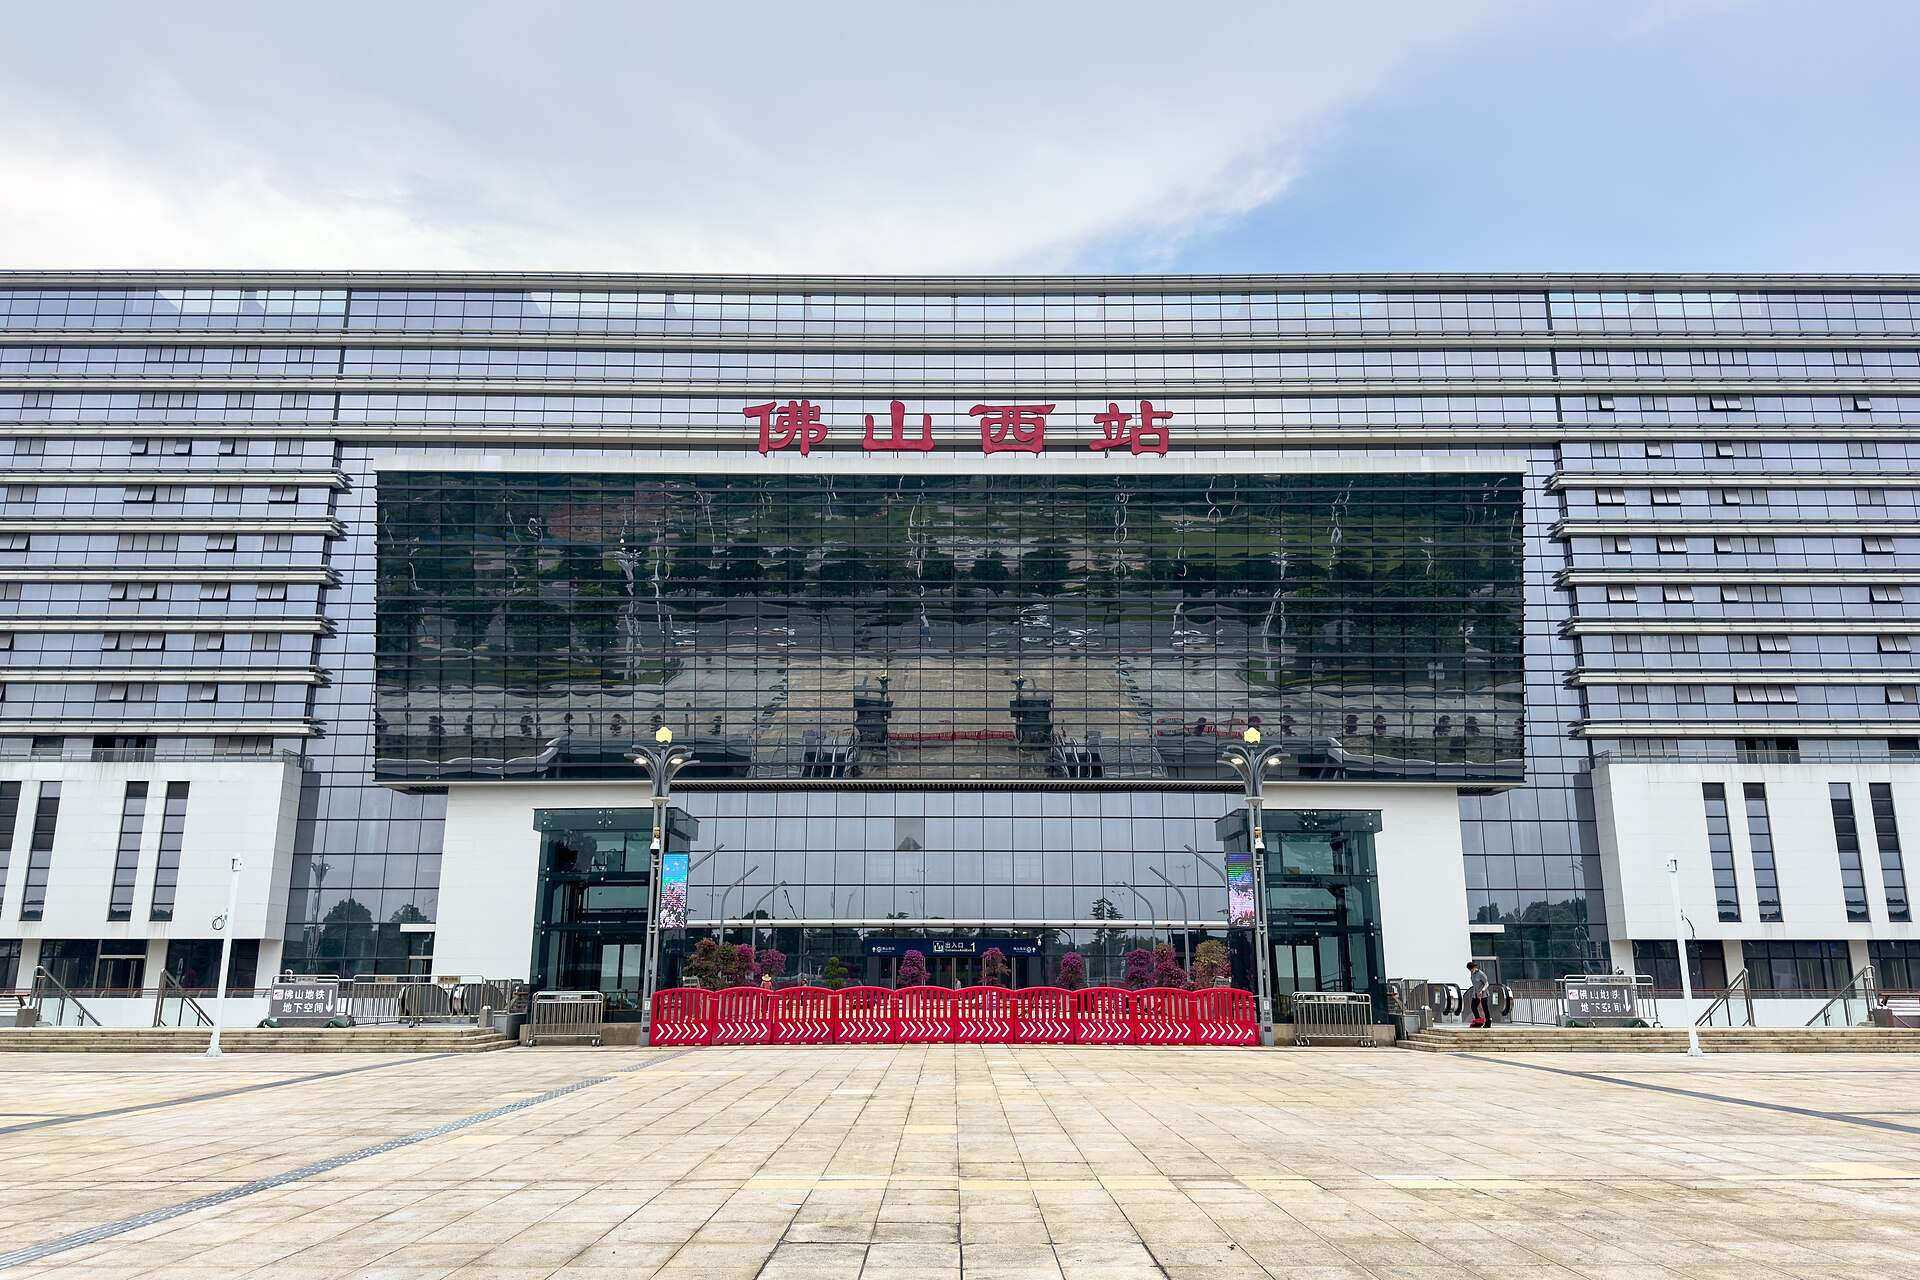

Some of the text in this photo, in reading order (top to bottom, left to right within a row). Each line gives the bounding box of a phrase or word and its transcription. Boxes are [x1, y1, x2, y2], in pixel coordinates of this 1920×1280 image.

[743, 399, 1174, 456] 佛山西站
[944, 941, 976, 953] 出入口 1
[284, 989, 325, 1000] 佛山地铁
[282, 1002, 324, 1013] 地下空间
